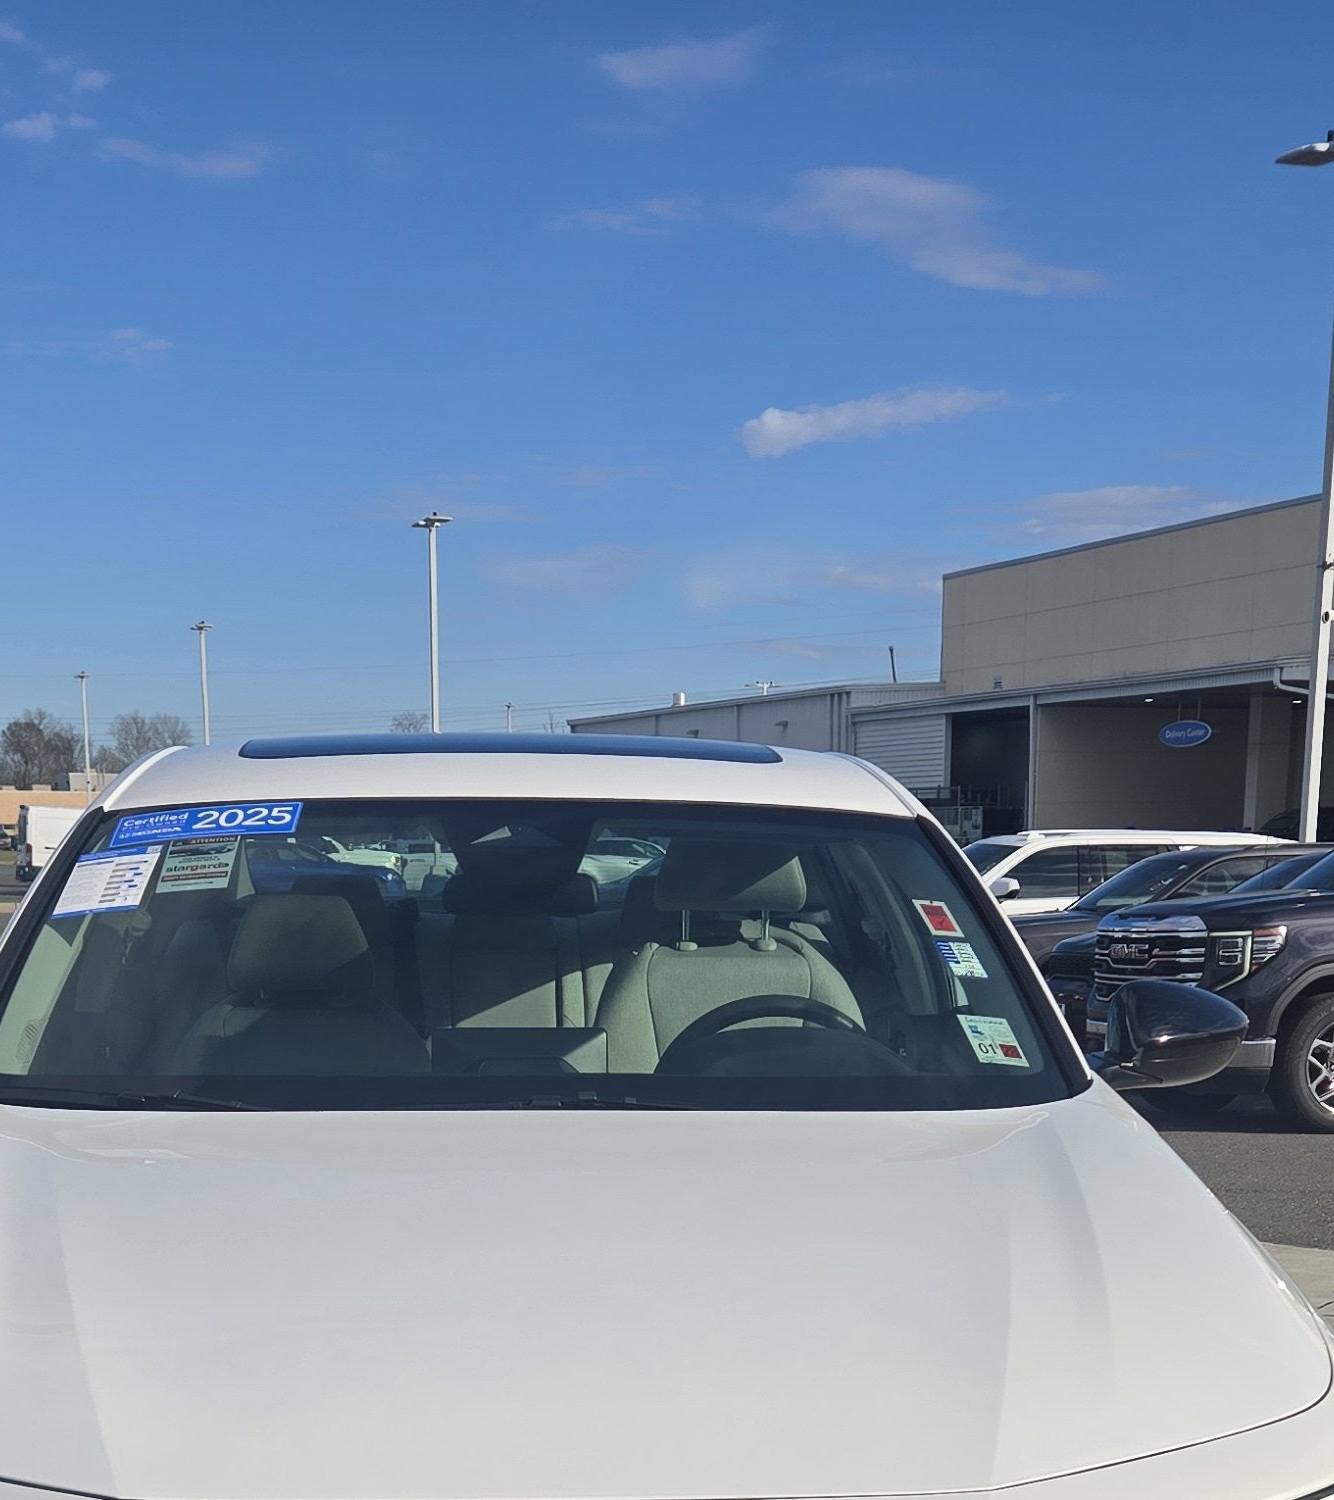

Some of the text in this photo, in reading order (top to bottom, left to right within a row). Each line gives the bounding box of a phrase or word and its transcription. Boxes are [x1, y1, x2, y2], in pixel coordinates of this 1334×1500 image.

[123, 812, 189, 828] Certified
[192, 807, 293, 829] 2025
[190, 836, 236, 844] ATTENTION
[1110, 943, 1149, 959] GMC
[978, 1042, 997, 1055] 01
